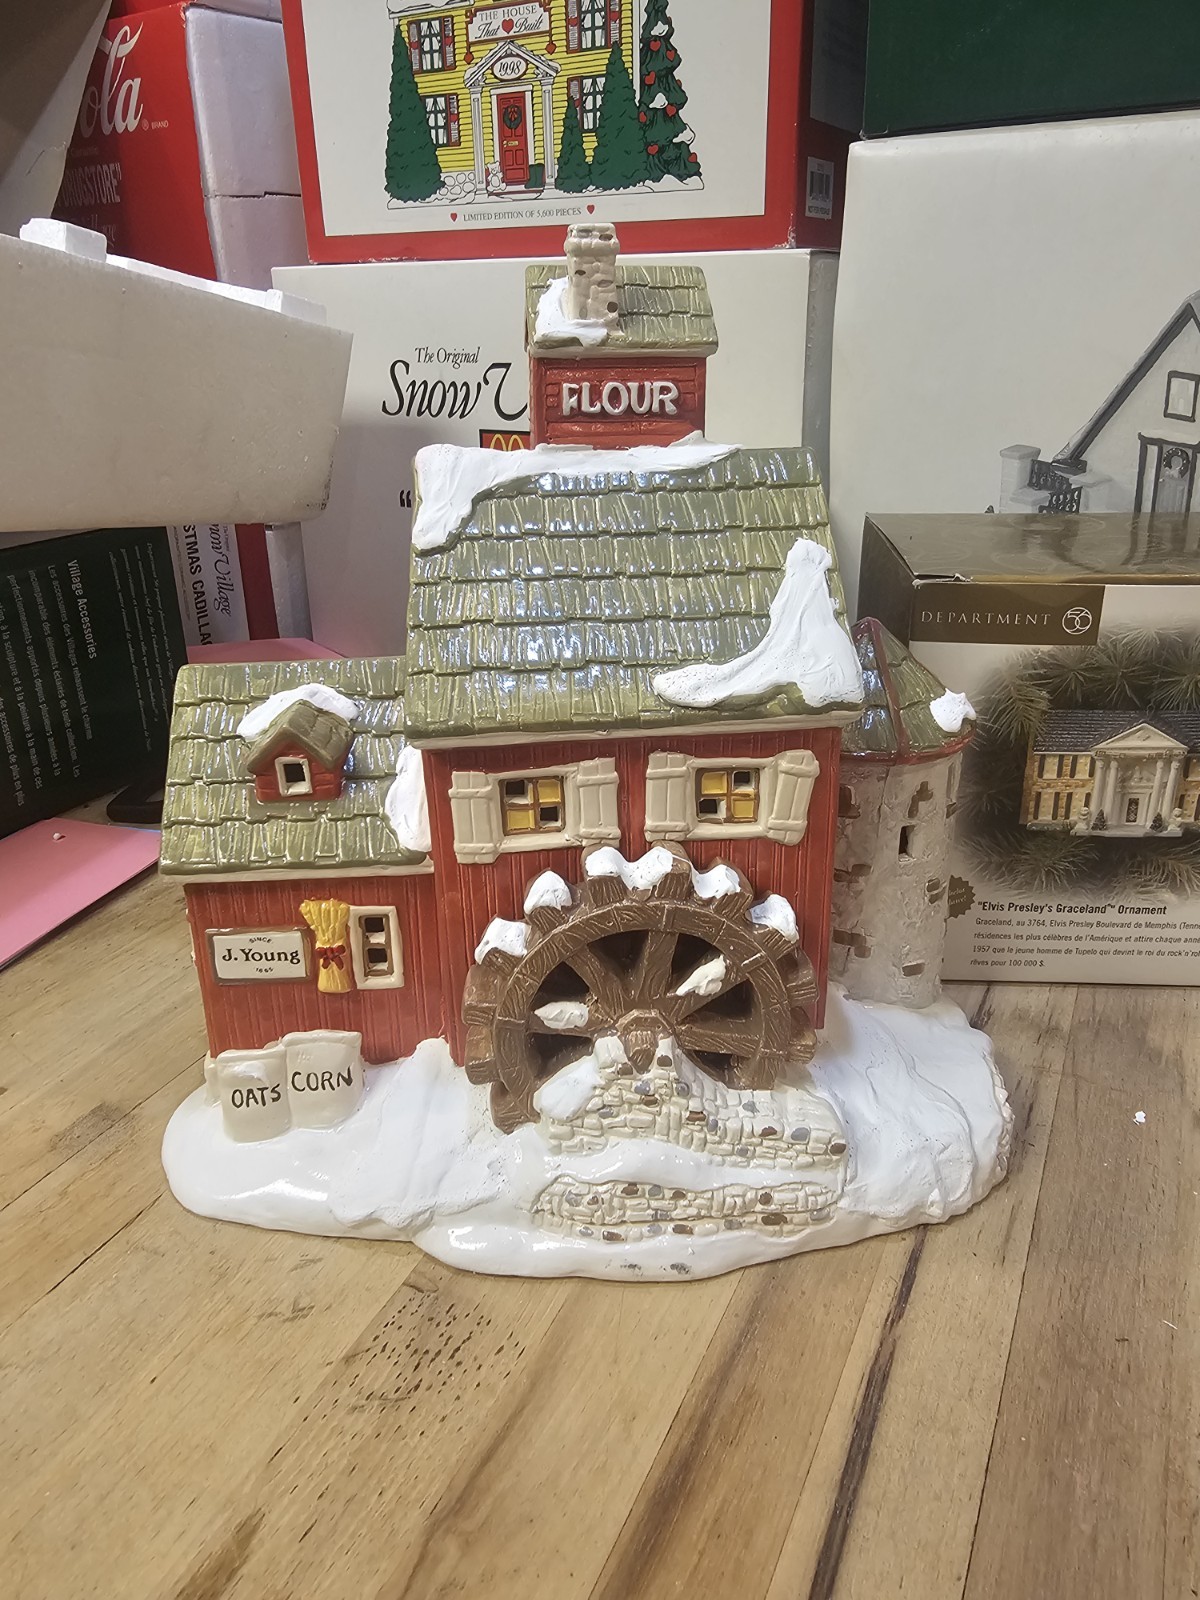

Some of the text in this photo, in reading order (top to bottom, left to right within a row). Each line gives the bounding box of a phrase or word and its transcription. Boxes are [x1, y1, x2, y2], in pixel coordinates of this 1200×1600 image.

[478, 4, 538, 22] THE HOUSE
[475, 13, 543, 39] That Built
[498, 60, 522, 77] 1998
[463, 212, 493, 222] LIMITED
[494, 210, 524, 220] EDITION
[525, 209, 535, 219] OF
[555, 207, 582, 217] PIECES
[415, 346, 480, 369] The Original
[381, 359, 481, 420] Snow
[562, 381, 679, 416] FLOUR
[213, 552, 235, 617] Village
[67, 560, 96, 658] Village Accessories
[921, 610, 1051, 626] DEPARTMENT
[4, 641, 17, 676] sculpture
[9, 764, 19, 780] plus
[1008, 902, 1053, 914] Presley's
[1118, 904, 1167, 915] Ornament
[1050, 919, 1067, 927] Elvis
[1069, 920, 1095, 929] Presley
[1096, 921, 1132, 929] Boulevard
[1134, 921, 1143, 929] de
[1145, 922, 1177, 930] Memphis
[1014, 933, 1024, 941] les
[1026, 933, 1041, 942] plus
[1074, 934, 1083, 942] de
[1155, 936, 1182, 944] chaque
[973, 945, 990, 953] 1957
[992, 946, 1005, 954] que
[1015, 946, 1035, 954] jeune
[1036, 946, 1062, 954] homme
[1075, 948, 1098, 956] Tupelo
[1009, 959, 1022, 967] 100
[1024, 959, 1037, 967] 000
[291, 1066, 354, 1093] CORN
[231, 1084, 282, 1109] OATS
